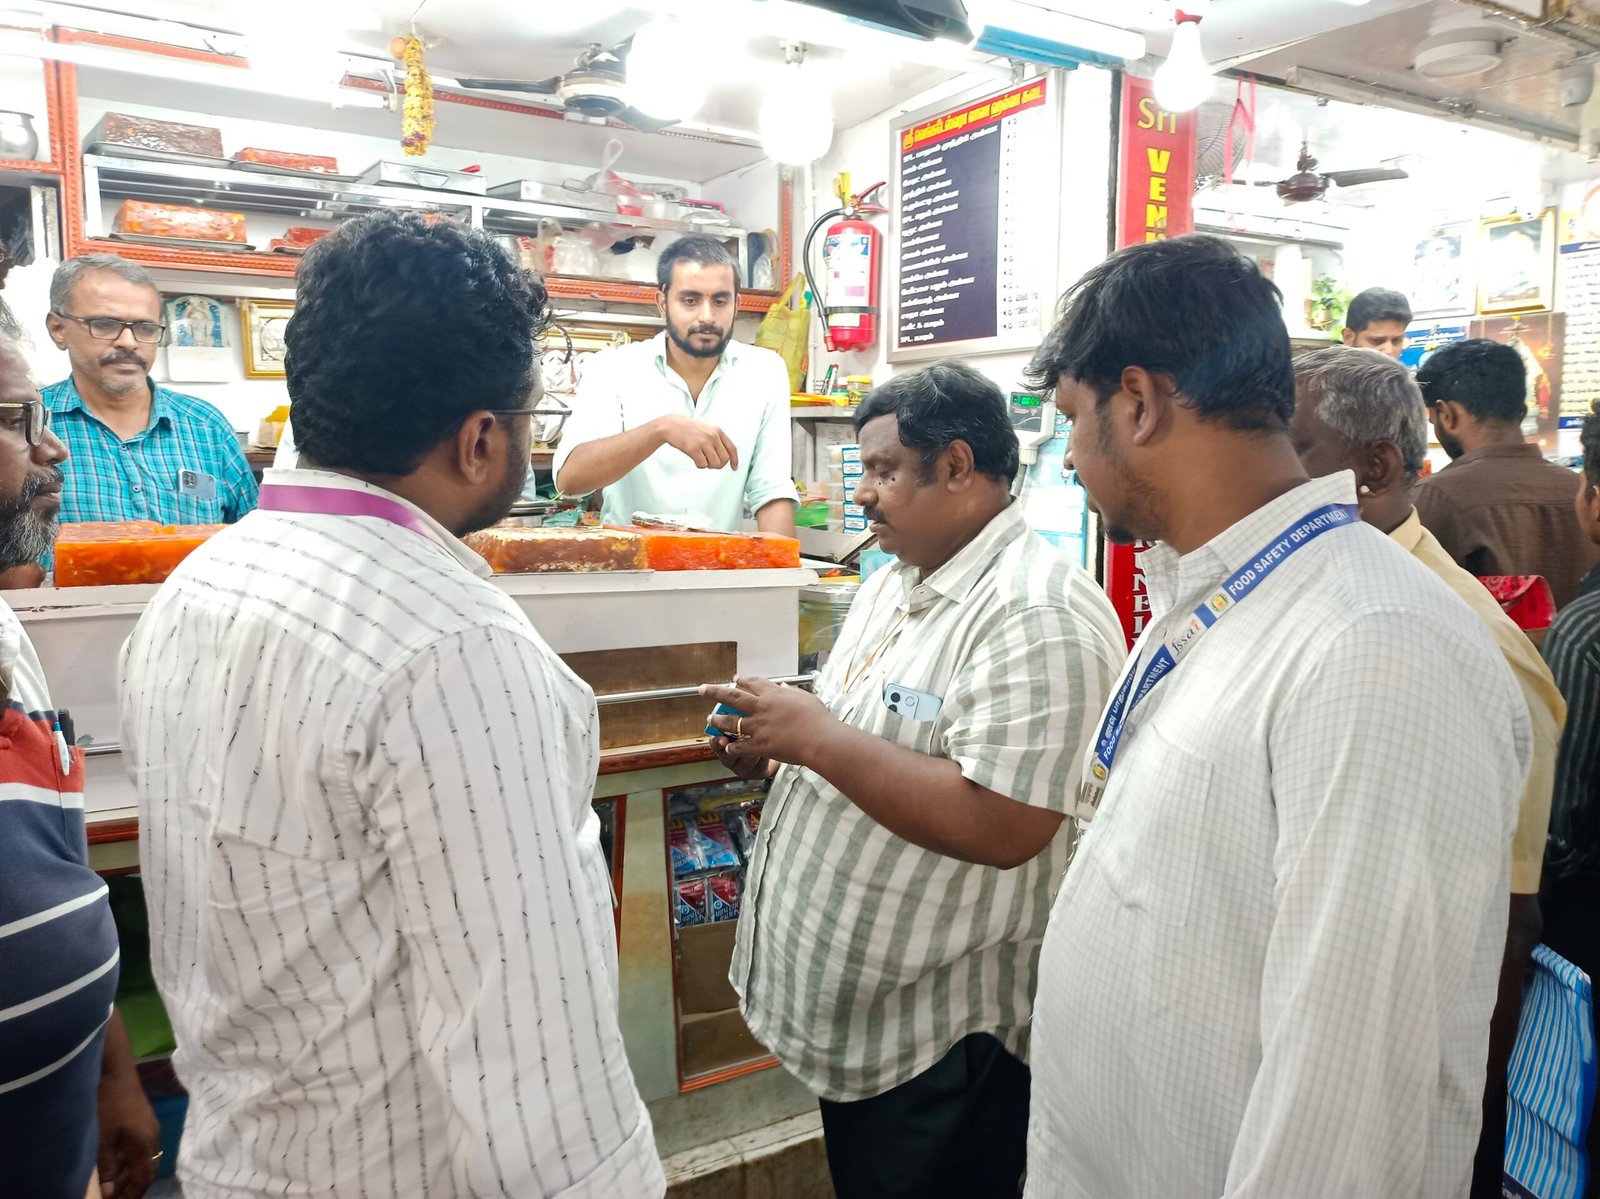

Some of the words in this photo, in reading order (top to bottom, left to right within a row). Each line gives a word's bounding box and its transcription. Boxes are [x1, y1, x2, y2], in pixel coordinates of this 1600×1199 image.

[1228, 569, 1257, 596] FOOD
[1254, 539, 1292, 573] SAFETY
[1289, 509, 1348, 543] DEPARTMENT
[1103, 734, 1117, 761] FOOD
